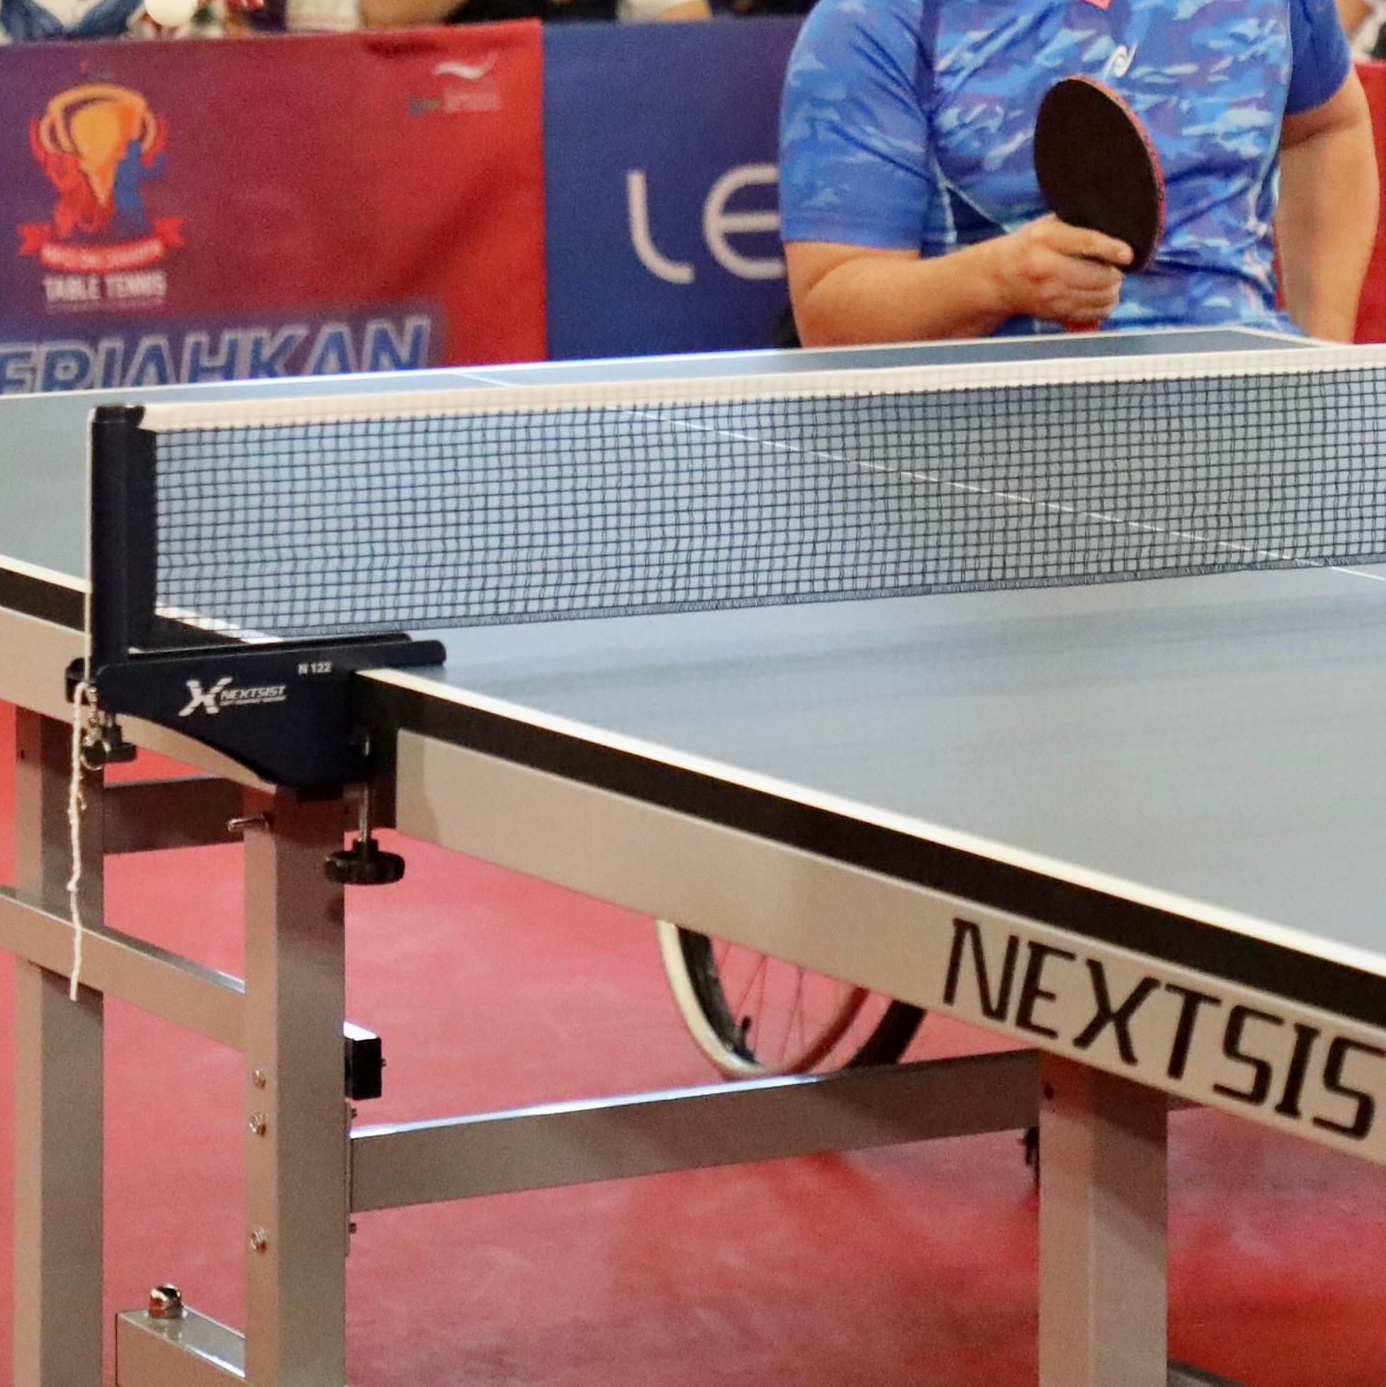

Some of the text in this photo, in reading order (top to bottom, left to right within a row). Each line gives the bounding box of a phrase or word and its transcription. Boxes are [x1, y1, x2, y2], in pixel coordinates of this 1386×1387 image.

[43, 269, 167, 302] TABLE TENNIS
[312, 661, 332, 674] 122
[220, 685, 287, 700] NEXTSIST
